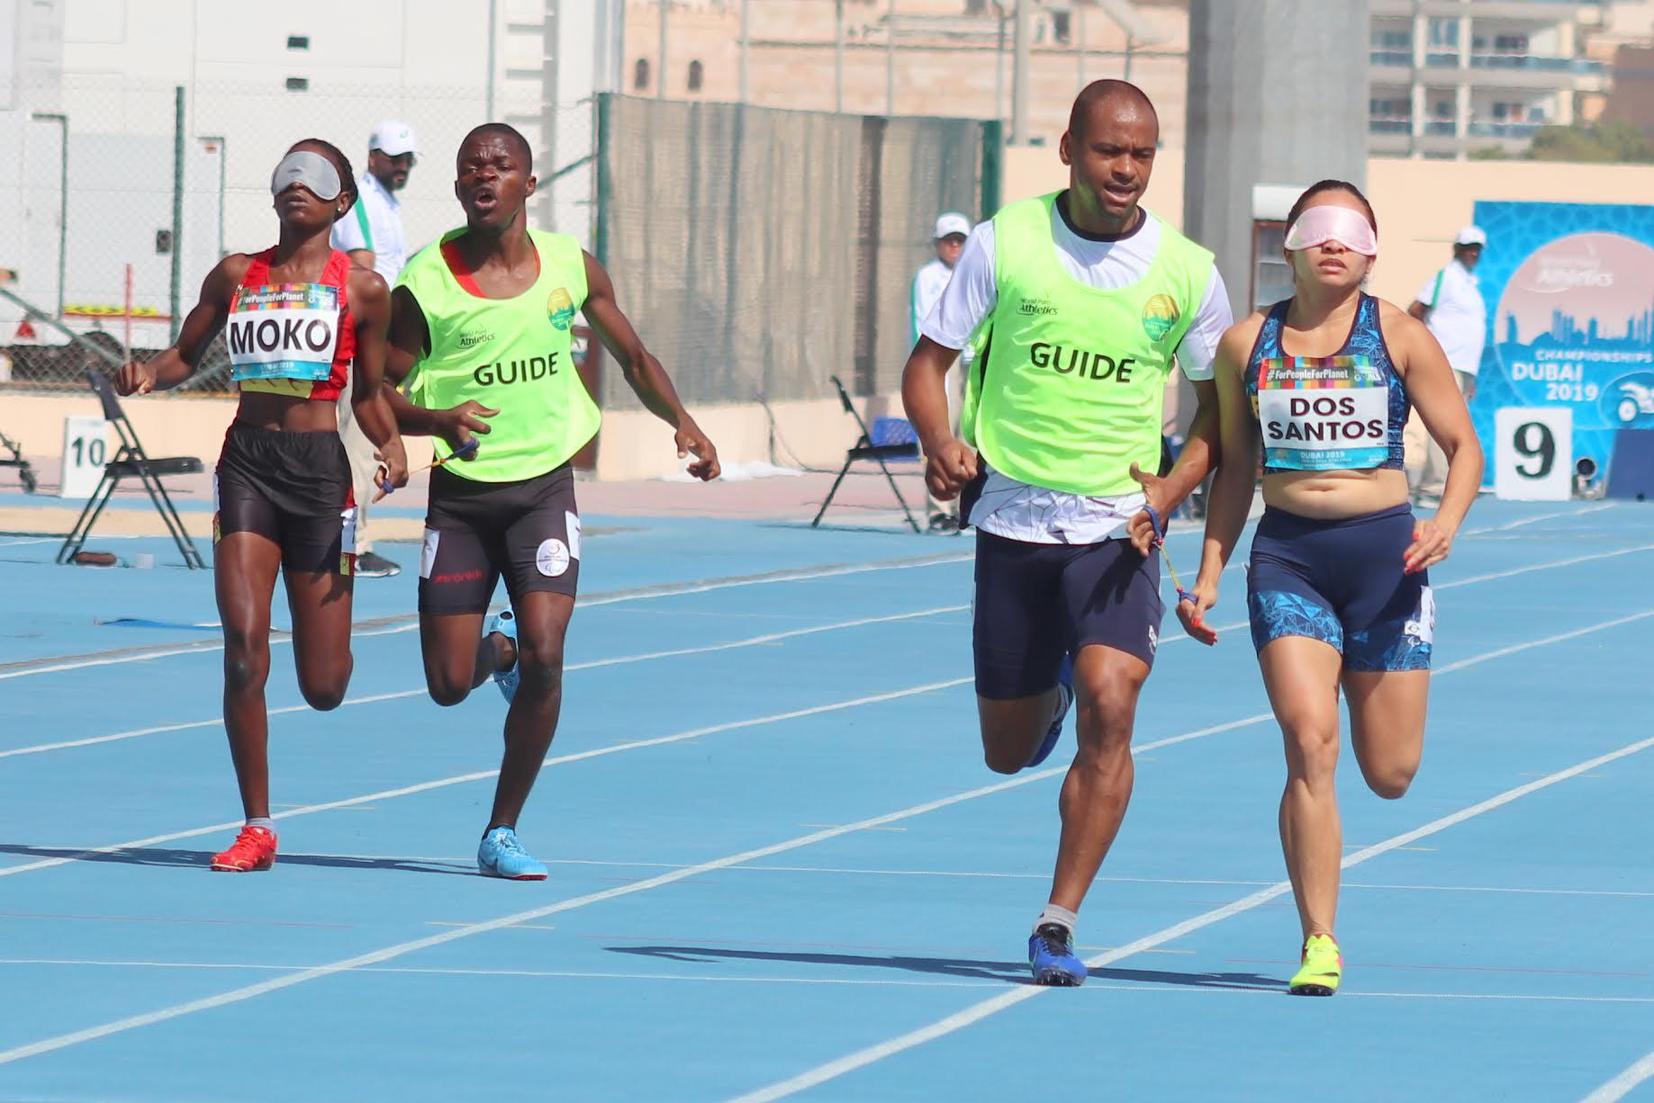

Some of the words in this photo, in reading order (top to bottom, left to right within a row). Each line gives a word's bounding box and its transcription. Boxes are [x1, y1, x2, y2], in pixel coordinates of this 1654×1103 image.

[230, 319, 331, 354] MOKO
[1030, 342, 1136, 383] GUIDE
[1535, 350, 1653, 363] CHAMPIONSHIPS
[473, 352, 559, 386] GUIDE
[1267, 369, 1349, 380] #ForPeopleForPlanet
[1511, 363, 1584, 381] DUBAI
[1546, 383, 1599, 401] 2019
[1290, 397, 1355, 417] DOS
[1267, 420, 1384, 441] SANTOS
[72, 436, 105, 469] 10
[1513, 422, 1555, 480] 9
